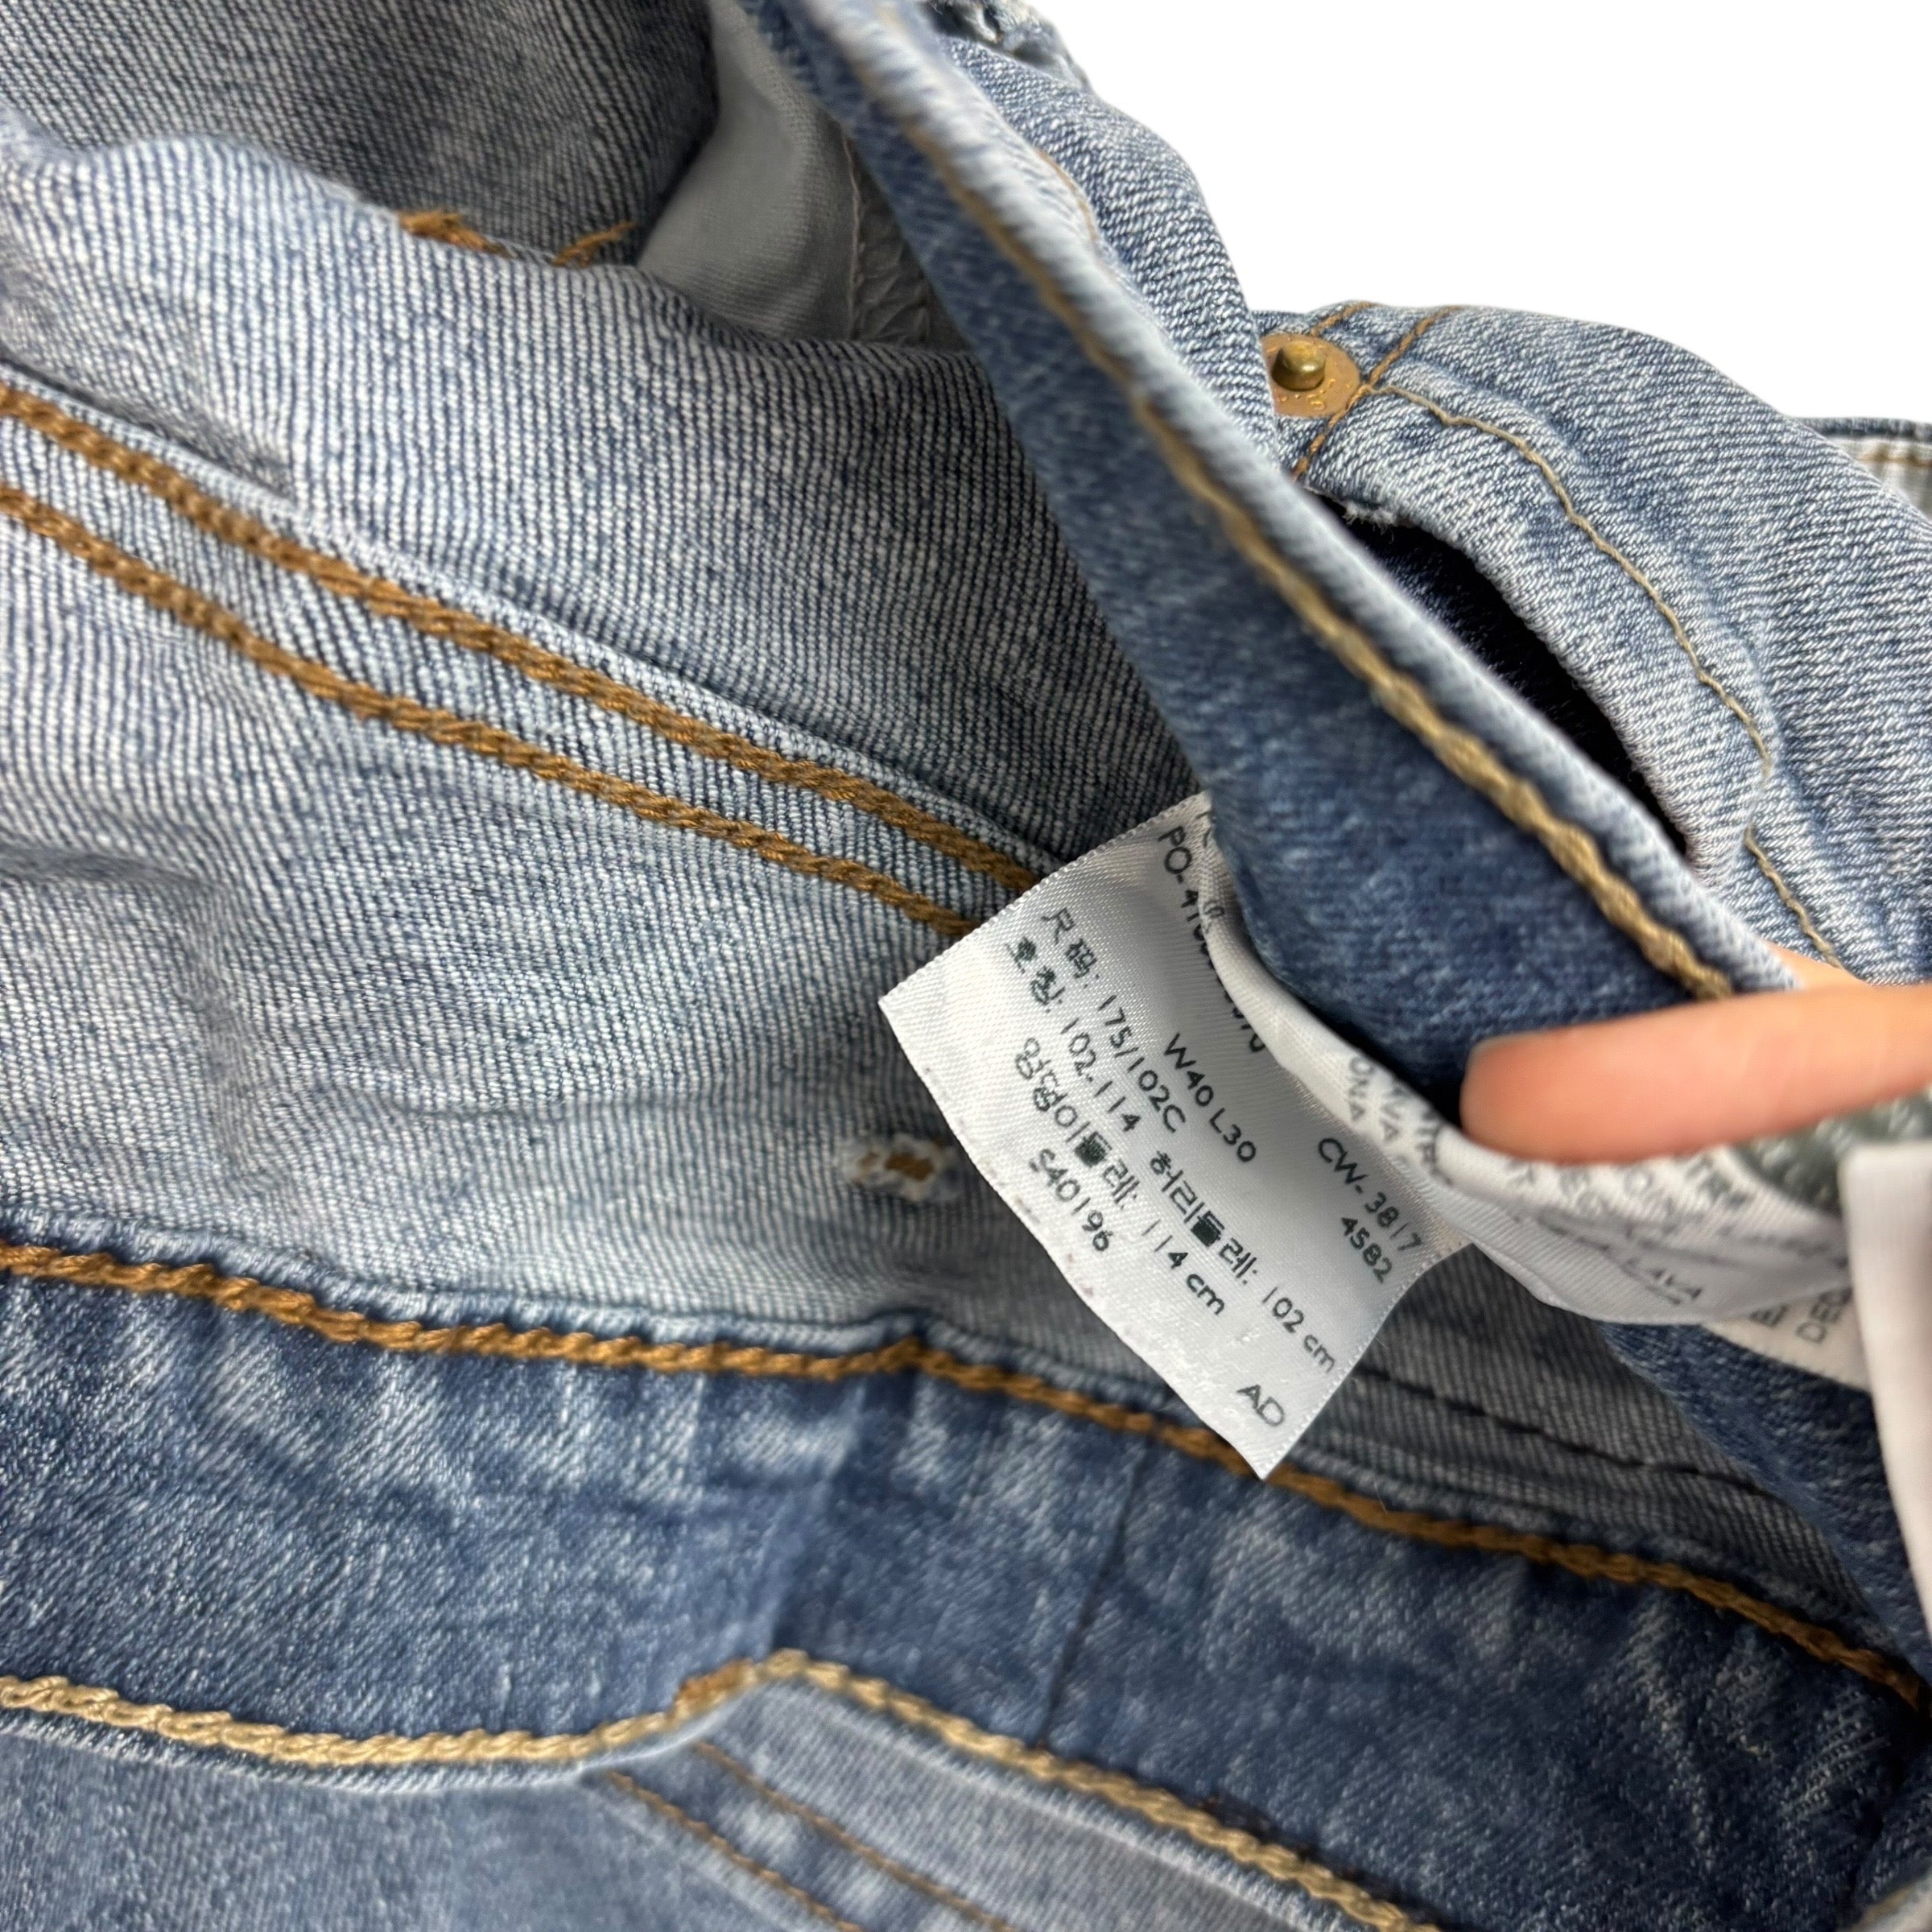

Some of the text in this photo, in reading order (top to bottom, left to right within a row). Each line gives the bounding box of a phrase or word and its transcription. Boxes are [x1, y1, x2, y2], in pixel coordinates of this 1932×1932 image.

[1097, 994, 1186, 1133] 175/102C
[1163, 1032, 1215, 1108] W40
[1209, 1107, 1257, 1162] L30
[1029, 1149, 1114, 1253] S40196
[1340, 1216, 1393, 1283] 4582
[1141, 1219, 1189, 1269] 114
[1186, 1273, 1226, 1316] cm
[1262, 1286, 1305, 1333] 102
[1303, 1334, 1335, 1373] cm
[1236, 1384, 1286, 1427] AD
